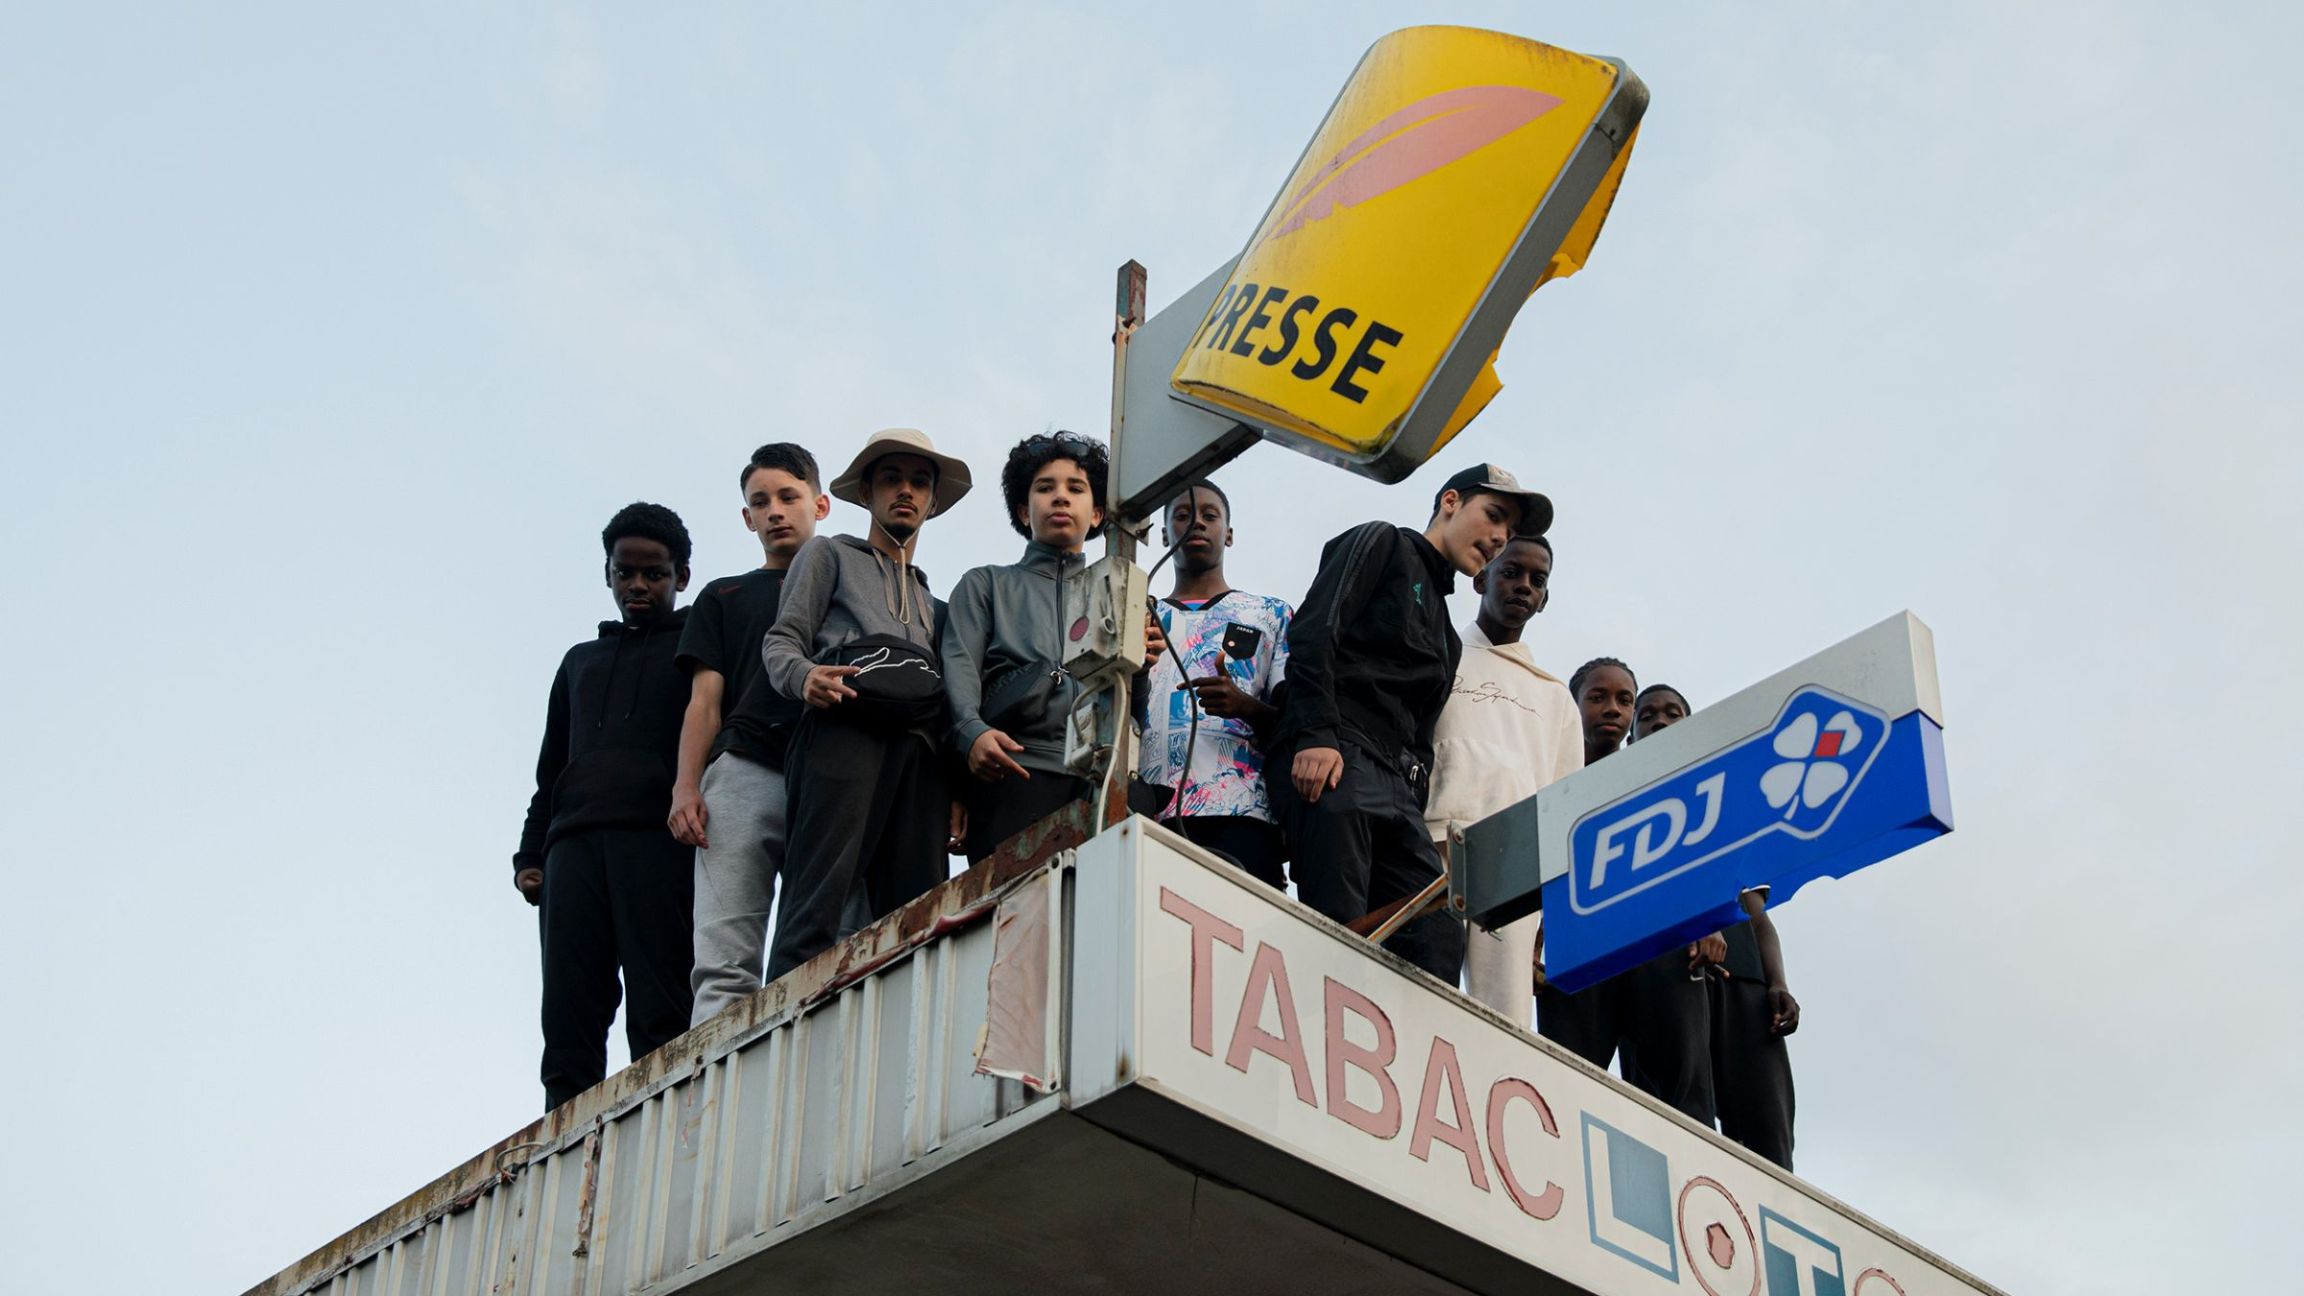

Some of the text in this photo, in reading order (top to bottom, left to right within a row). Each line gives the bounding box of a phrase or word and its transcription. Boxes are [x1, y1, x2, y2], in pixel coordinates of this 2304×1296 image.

[1193, 284, 1404, 404] PRESSE
[1590, 772, 1726, 890] FDJ
[1160, 886, 1907, 1296] TABAC LOT
